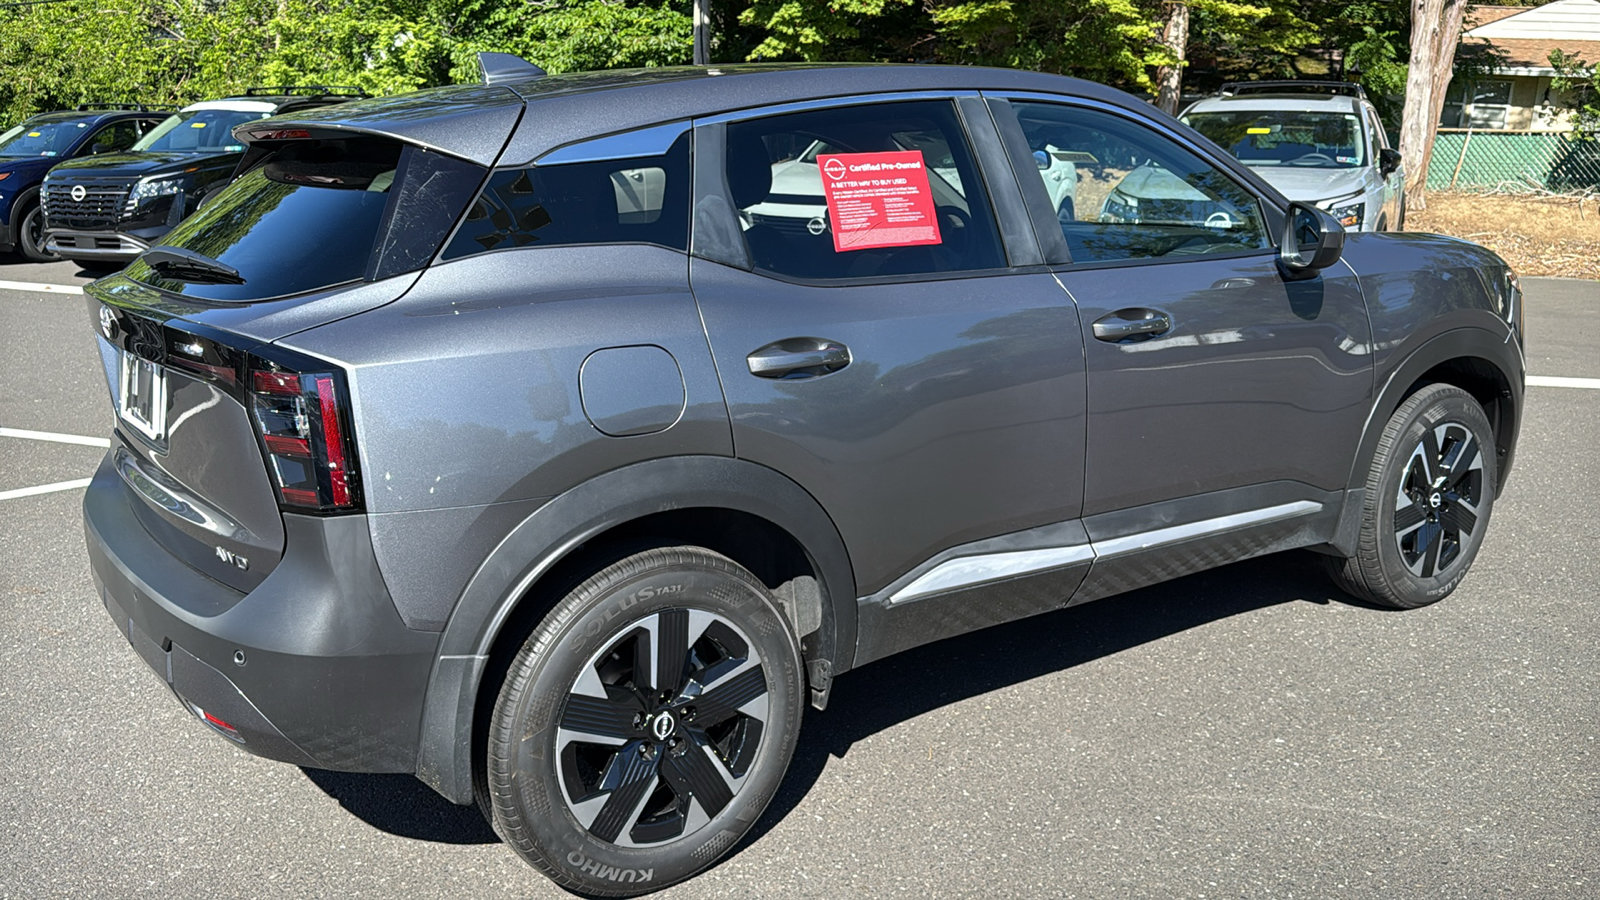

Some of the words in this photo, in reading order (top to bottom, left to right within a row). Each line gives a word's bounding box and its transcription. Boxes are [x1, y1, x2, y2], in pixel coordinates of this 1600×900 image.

[849, 163, 880, 172] Certified
[881, 161, 921, 171] Pre-Owned
[569, 585, 655, 654] SOLUS
[656, 584, 682, 596] TA31
[567, 851, 654, 883] KUMHO
